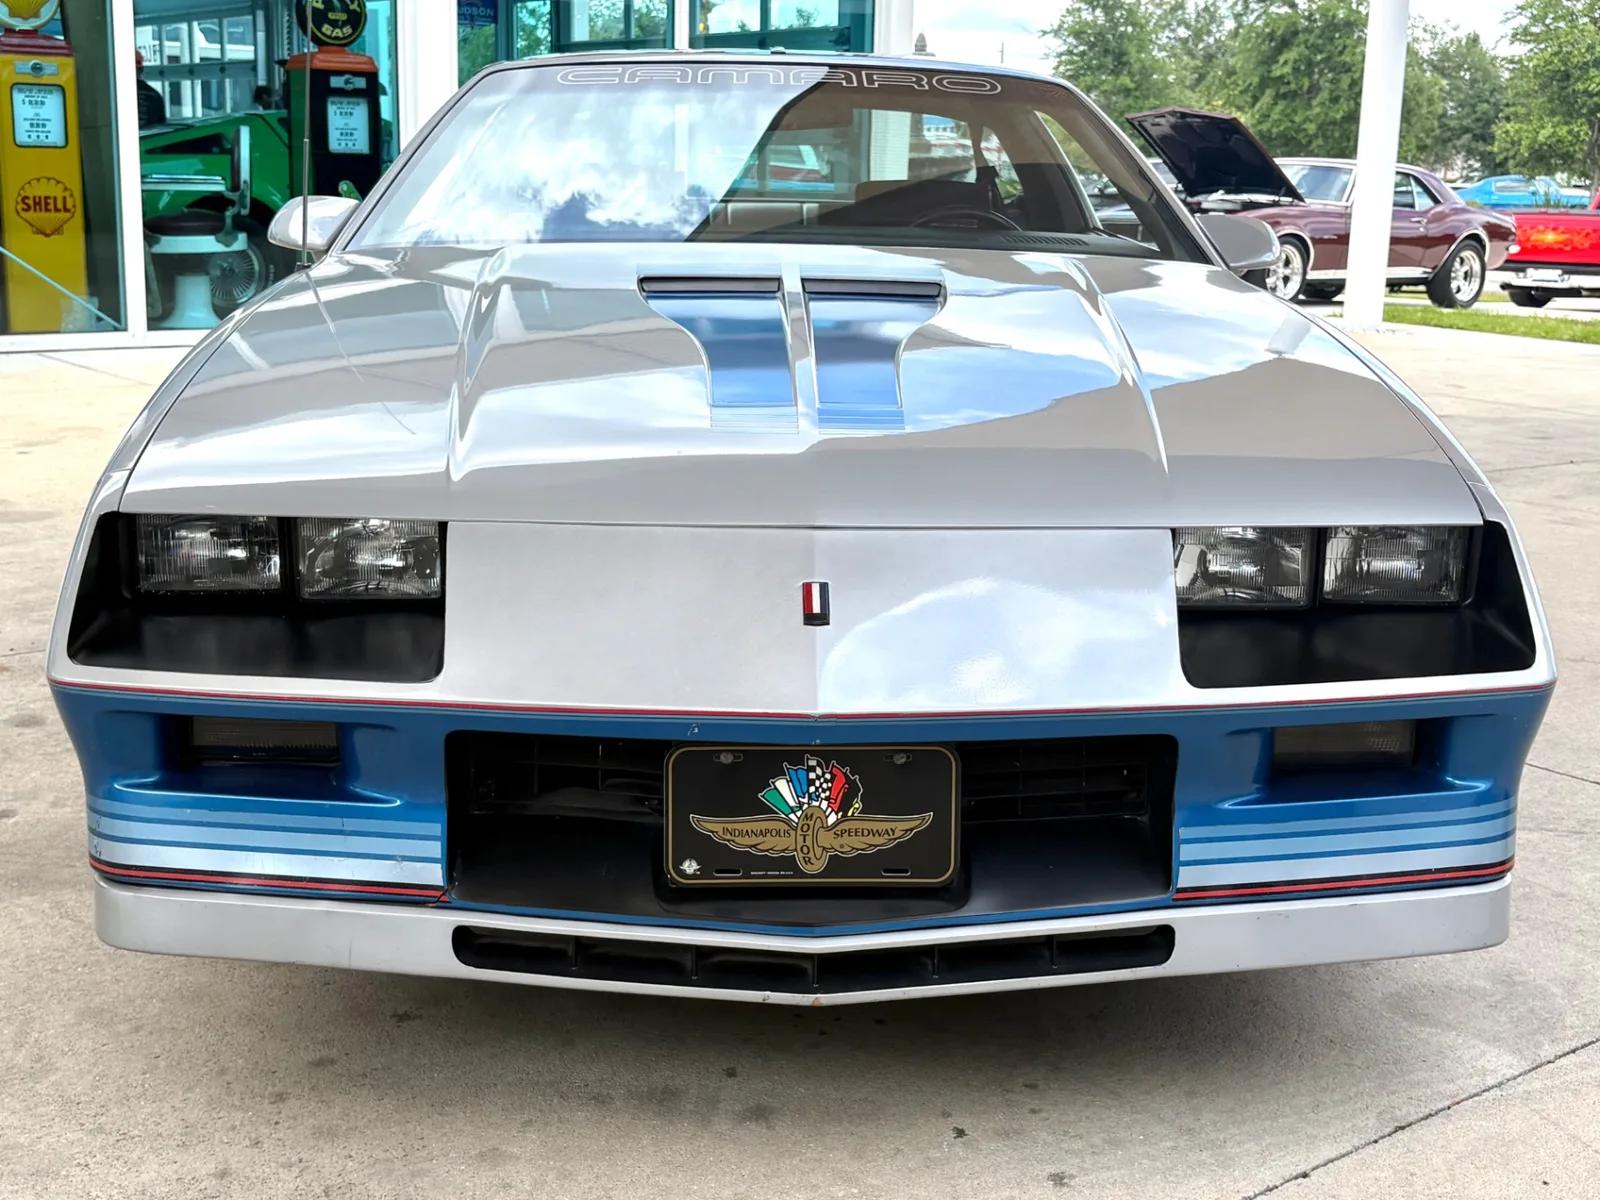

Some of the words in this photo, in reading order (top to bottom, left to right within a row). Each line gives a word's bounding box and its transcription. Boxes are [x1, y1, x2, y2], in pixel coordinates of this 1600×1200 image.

[321, 23, 353, 38] GAS
[556, 65, 1002, 95] CAMARO
[20, 195, 71, 213] SHELL
[722, 826, 792, 838] INDIANAPOLIS
[799, 812, 815, 866] MOTOR
[833, 826, 898, 840] SPEEDWAY
